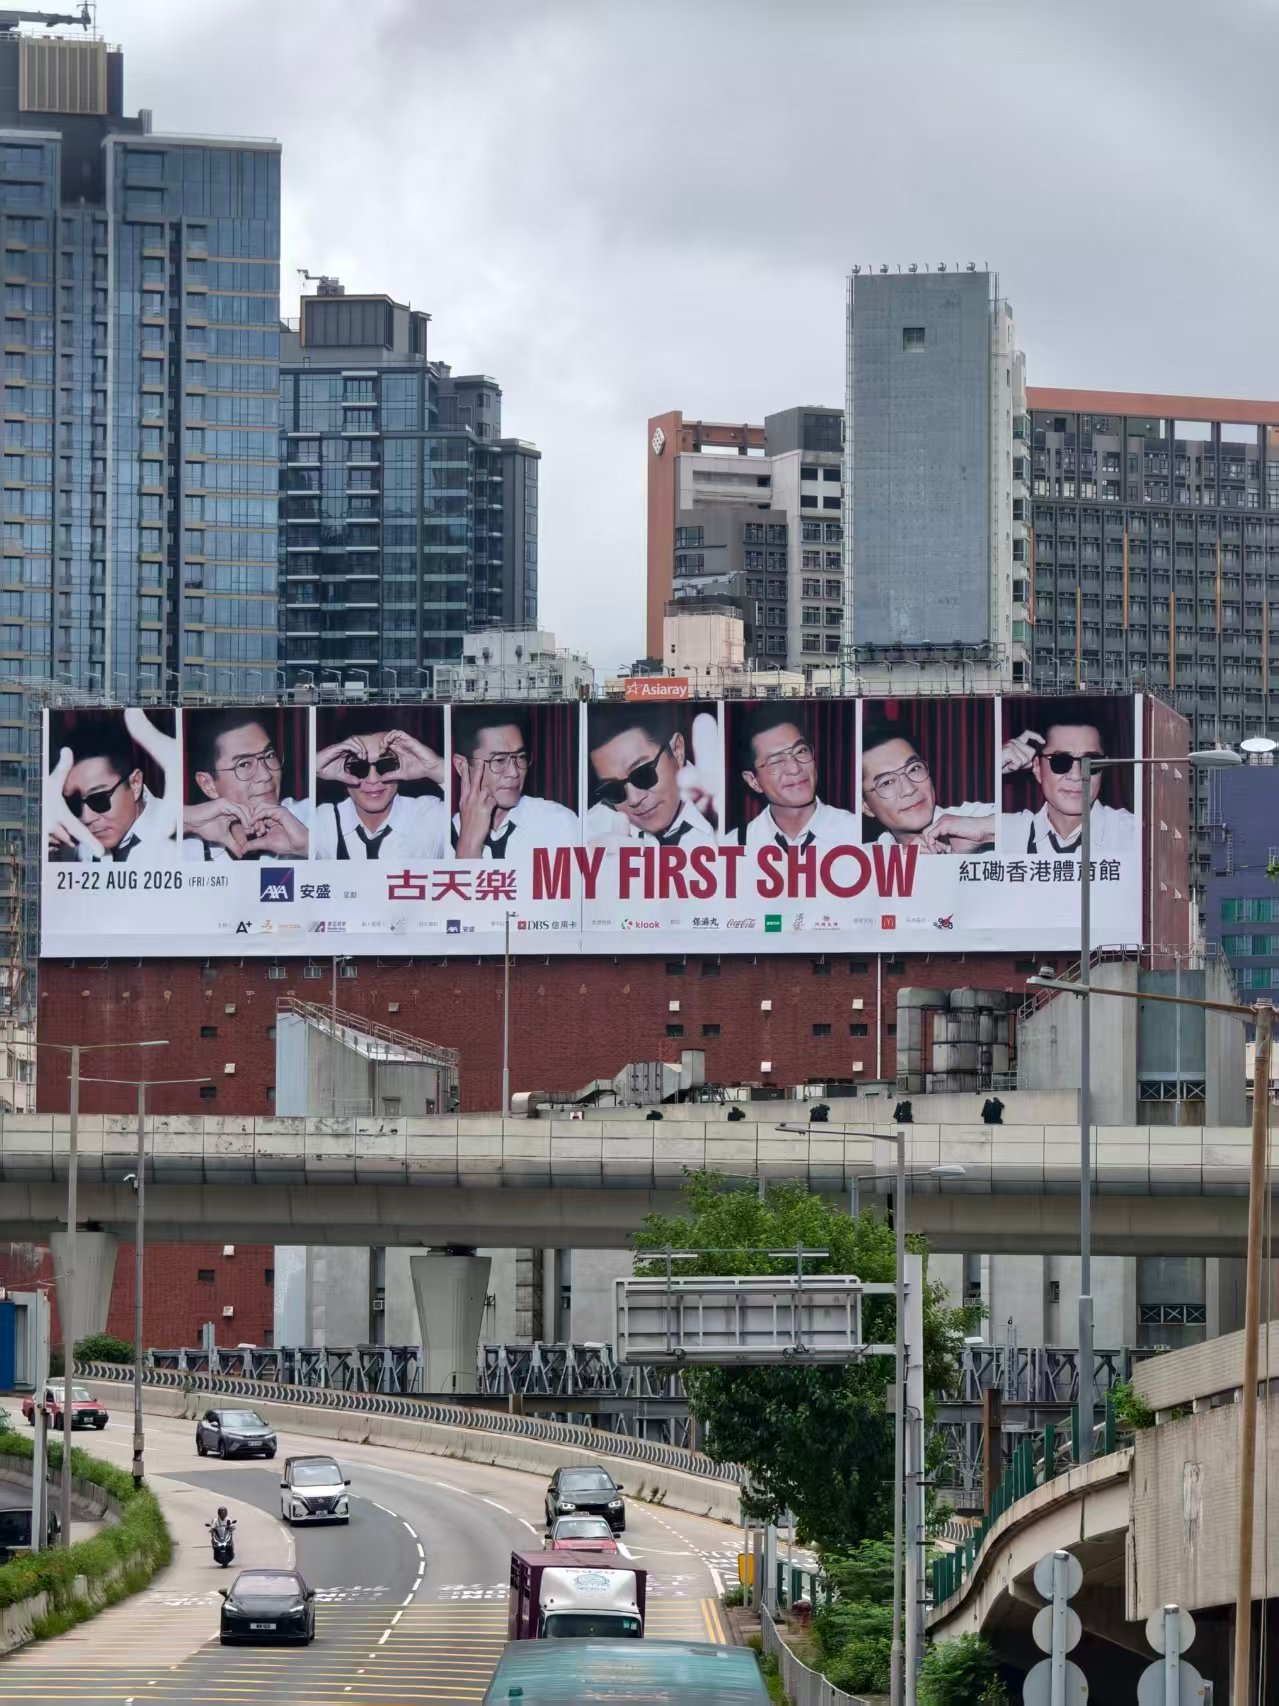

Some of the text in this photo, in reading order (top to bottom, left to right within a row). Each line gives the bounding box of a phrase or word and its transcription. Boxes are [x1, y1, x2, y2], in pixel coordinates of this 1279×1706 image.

[641, 683, 687, 698] Asiaray
[532, 844, 919, 900] MY FIRST SHOW
[959, 859, 1121, 883] 紅磡香港體育館
[57, 871, 100, 890] 21-22
[106, 870, 138, 890] AUG
[143, 870, 183, 890] 2026
[386, 869, 517, 901] 古天樂
[260, 885, 288, 899] AXA
[300, 884, 331, 899] 安盛
[527, 920, 549, 930] DBS
[551, 920, 577, 930] 信用卡
[635, 920, 660, 929] klook
